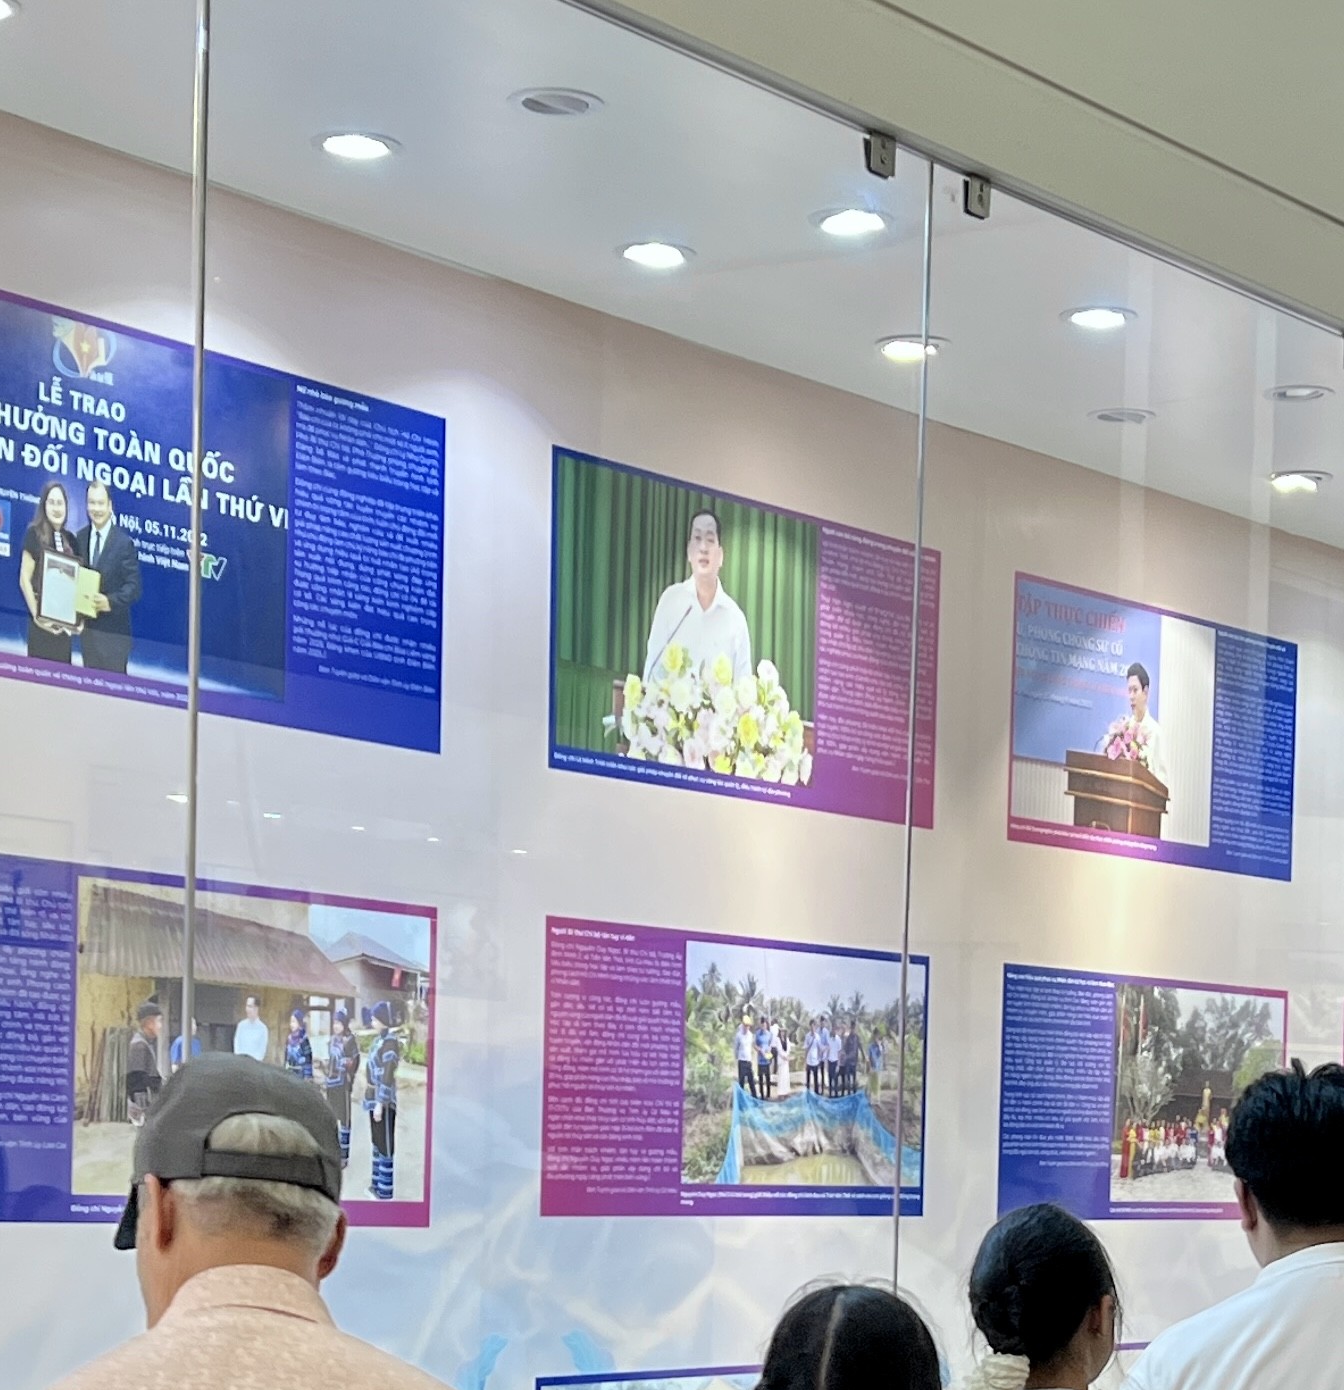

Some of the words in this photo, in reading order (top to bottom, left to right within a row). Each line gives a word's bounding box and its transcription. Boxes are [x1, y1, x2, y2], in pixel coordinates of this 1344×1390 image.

[38, 376, 63, 406] LỄ
[69, 390, 126, 423] TRAO
[94, 427, 161, 465] TOÀN
[21, 443, 68, 475] ĐỐI
[77, 456, 155, 499] NGOẠI
[216, 491, 264, 523] THỨ
[120, 513, 142, 535] Nội,
